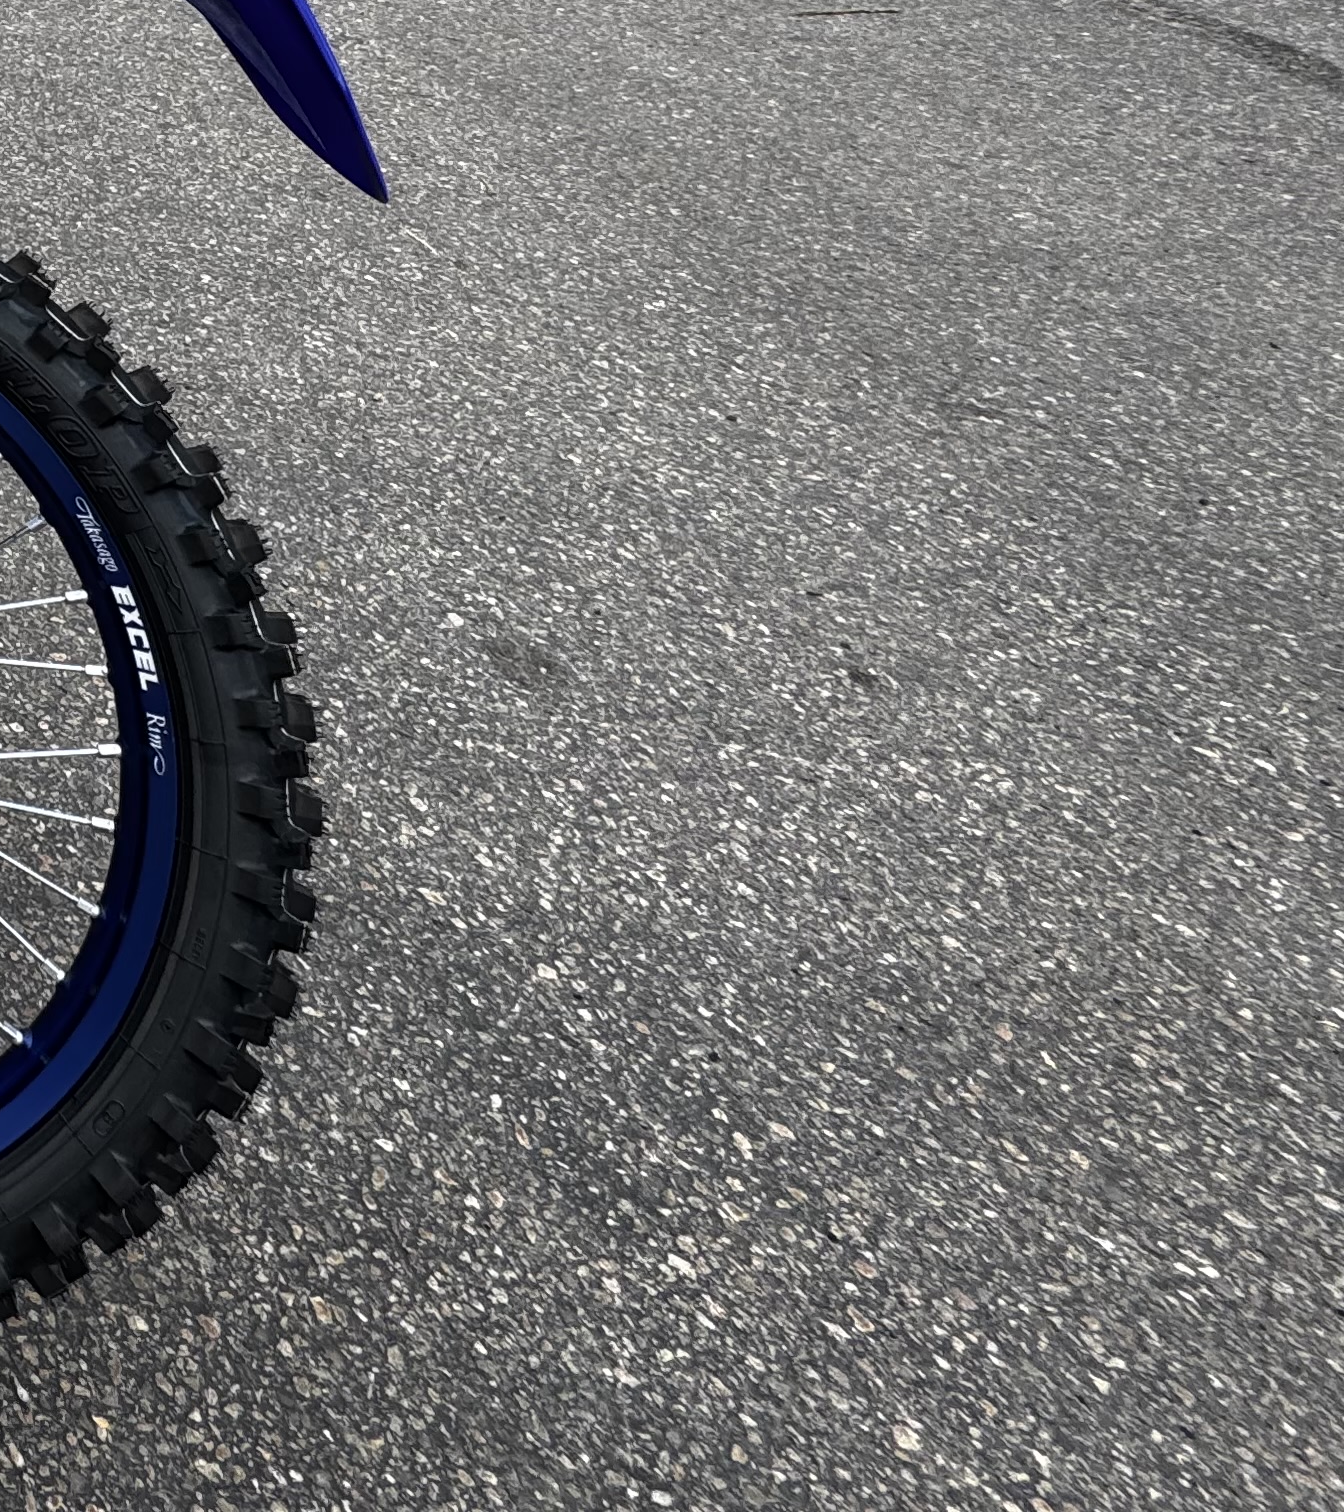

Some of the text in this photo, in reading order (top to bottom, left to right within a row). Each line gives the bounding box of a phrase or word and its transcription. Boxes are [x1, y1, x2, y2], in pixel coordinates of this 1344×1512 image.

[74, 495, 167, 776] Takasago EXCEL Rim
